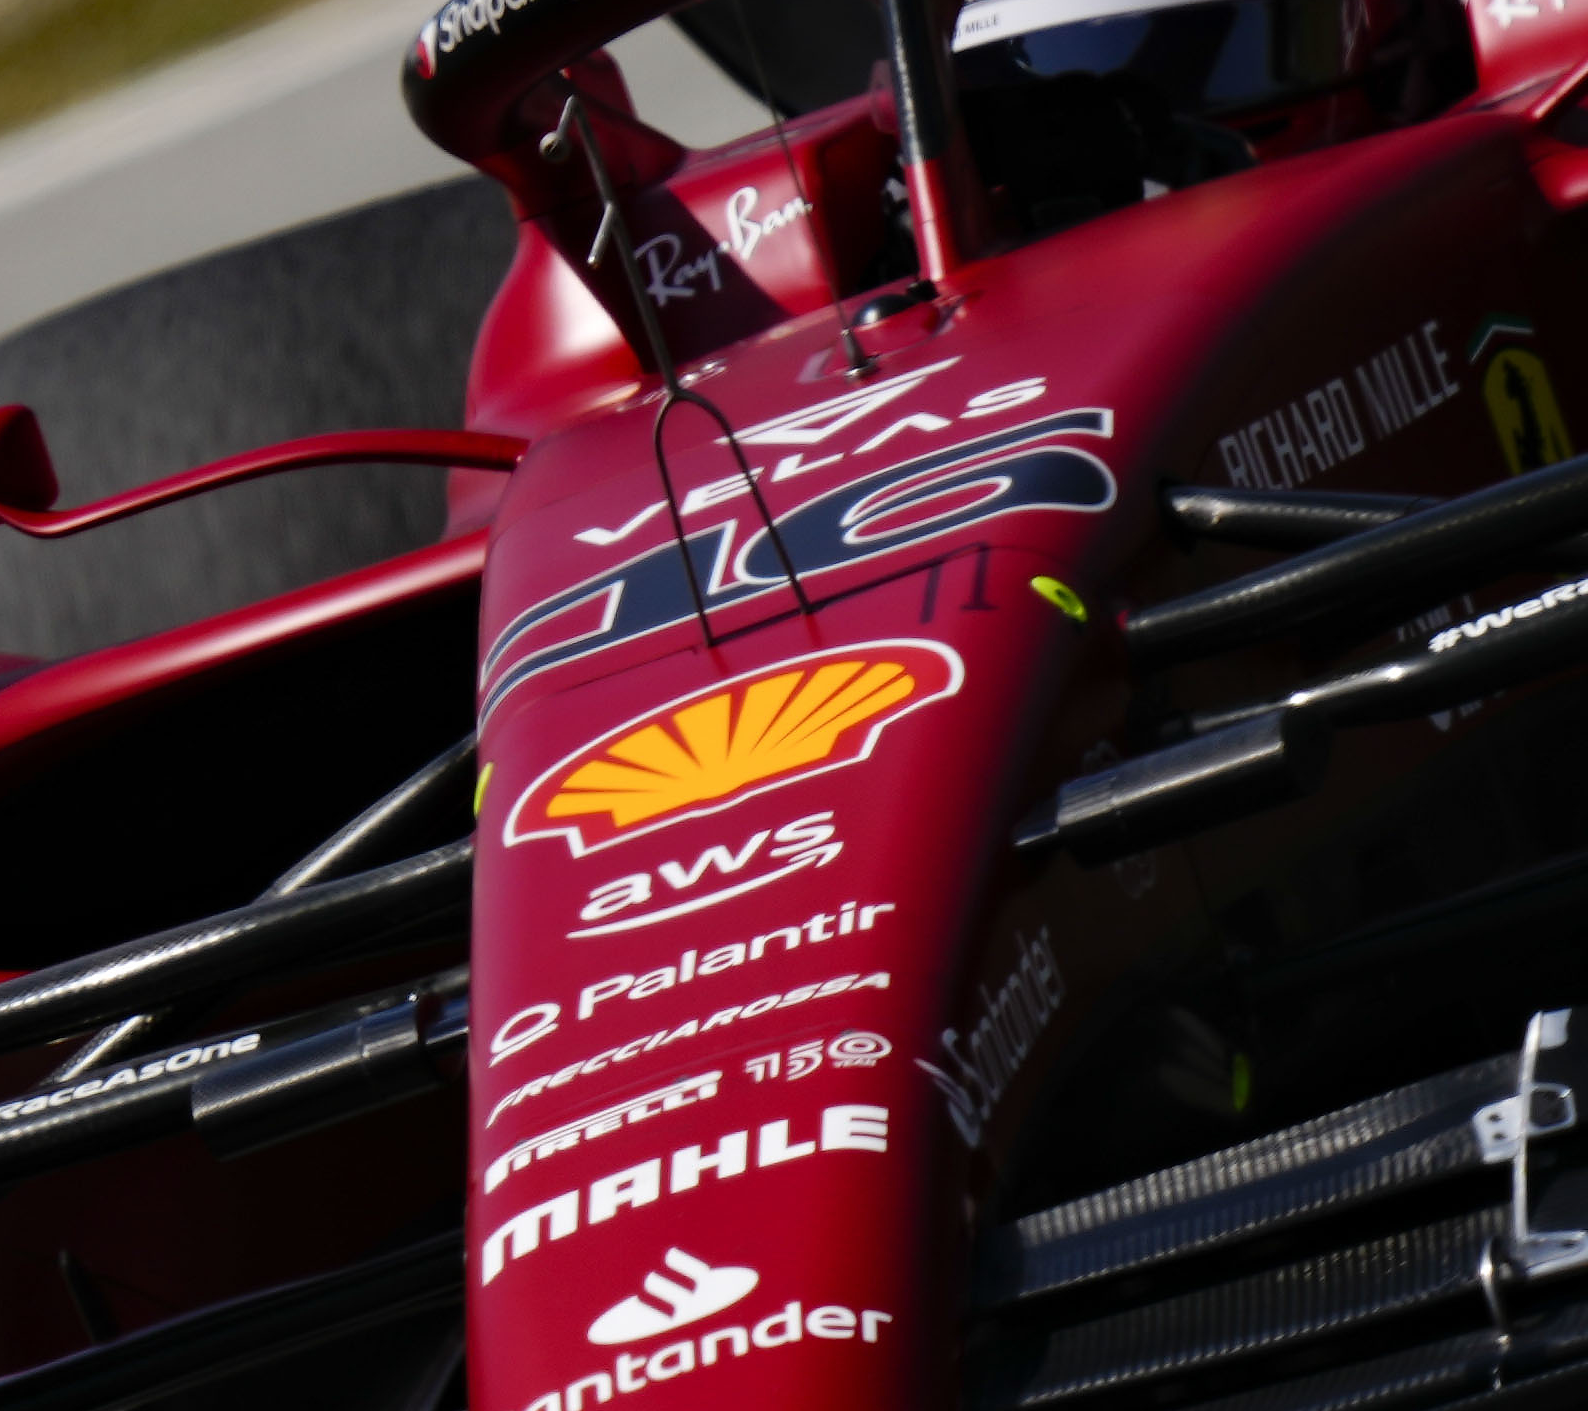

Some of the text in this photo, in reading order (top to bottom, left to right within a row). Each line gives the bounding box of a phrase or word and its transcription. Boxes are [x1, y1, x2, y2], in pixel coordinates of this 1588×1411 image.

[634, 186, 812, 307] Ray-Ban
[573, 377, 1047, 546] VELAS
[1218, 318, 1461, 490] RICHARD MILLE
[479, 408, 1118, 739] 16
[579, 811, 839, 921] aws
[578, 902, 896, 1019] Palantir
[941, 924, 1065, 1122] Santander
[484, 1070, 722, 1194] PIRELLI
[486, 972, 891, 1129] FRECCIAROSSA
[482, 1104, 889, 1287] MAHLE
